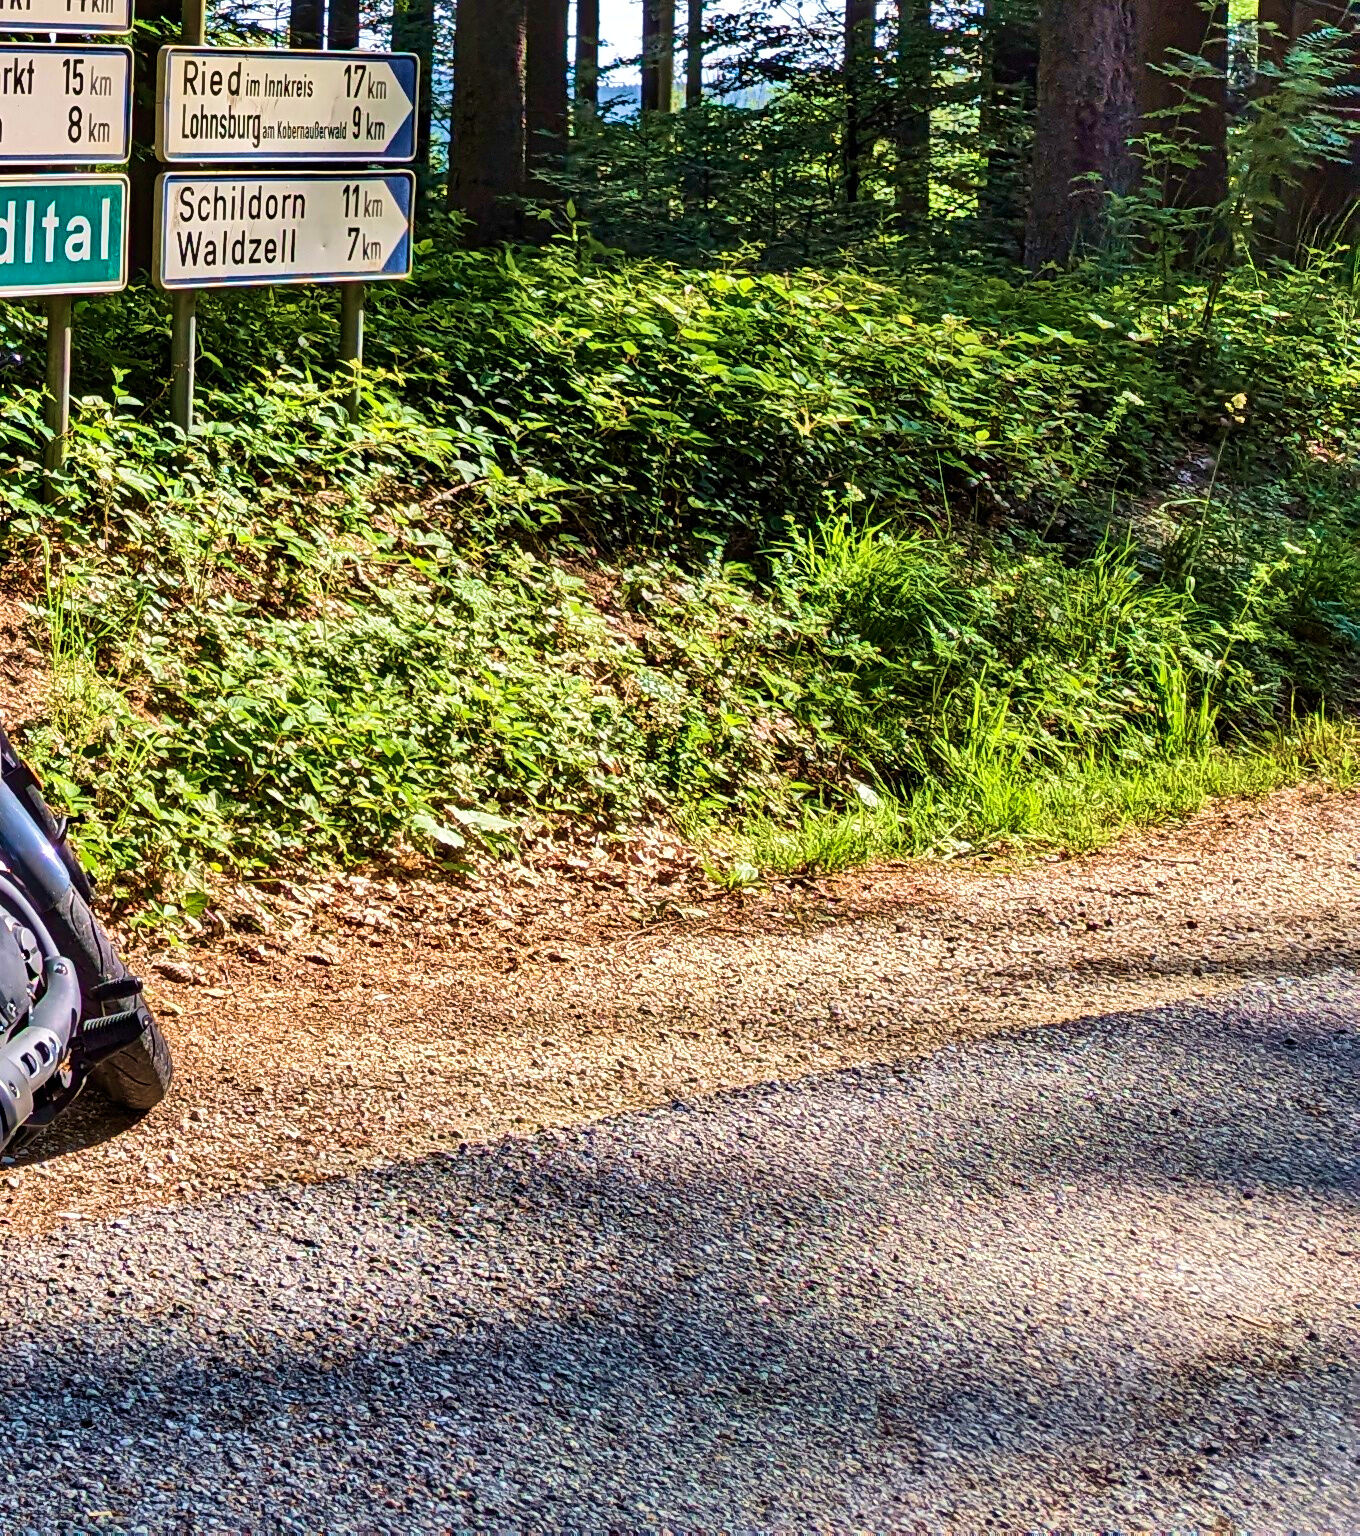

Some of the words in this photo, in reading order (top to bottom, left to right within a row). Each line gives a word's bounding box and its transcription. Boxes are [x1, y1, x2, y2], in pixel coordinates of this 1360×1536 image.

[62, 58, 84, 96] 15
[90, 66, 112, 96] km
[183, 60, 242, 97] Ried
[246, 73, 260, 97] im
[264, 73, 314, 97] Innkreis
[343, 64, 367, 99] 17
[367, 72, 386, 99] km
[68, 105, 83, 143] 8
[88, 113, 110, 143] km
[181, 104, 261, 148] Lohnsburg
[263, 125, 275, 139] am
[277, 121, 347, 140] Kobernaußerwald
[352, 106, 362, 139] 9
[366, 113, 385, 140] km
[179, 185, 306, 222] Schildorn
[342, 184, 360, 218] 11
[363, 190, 383, 218] km
[177, 229, 296, 267] Waldzell
[347, 227, 361, 261] 7
[362, 234, 382, 261] km
